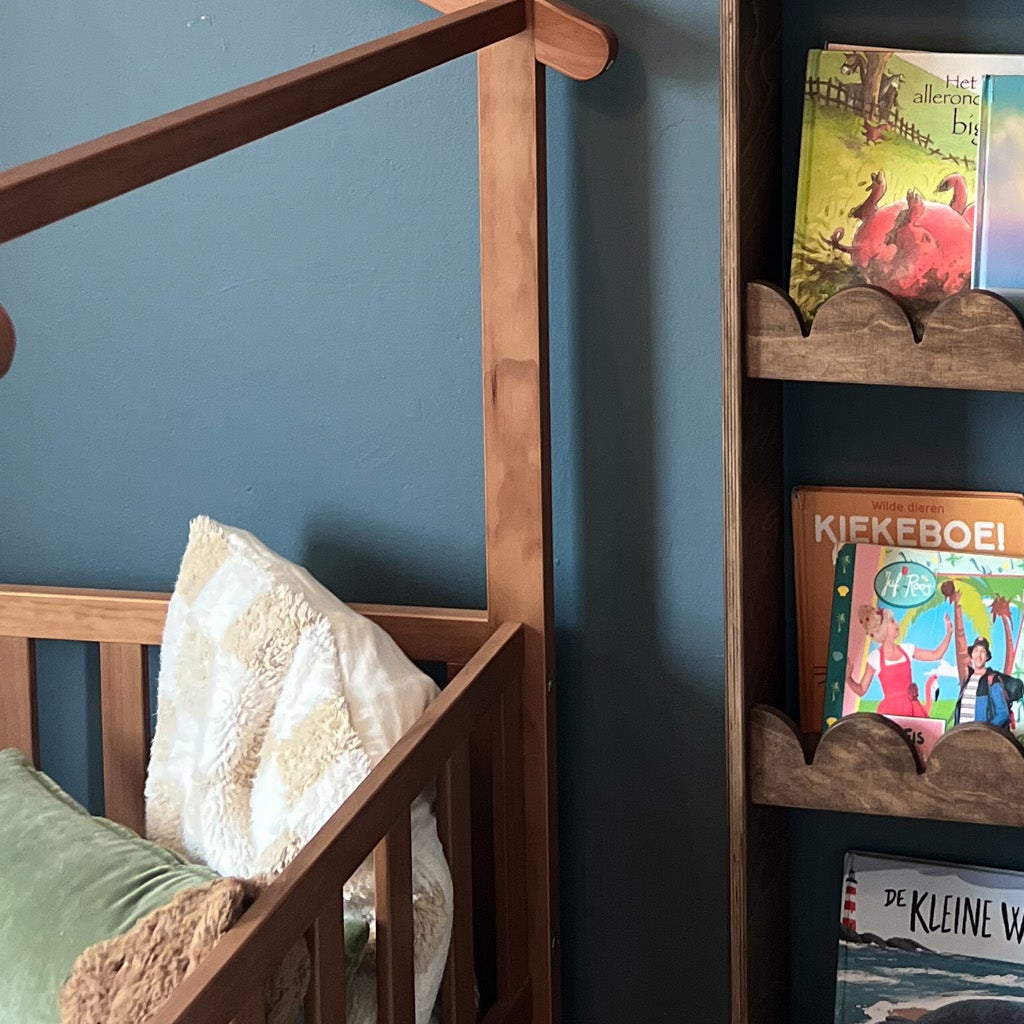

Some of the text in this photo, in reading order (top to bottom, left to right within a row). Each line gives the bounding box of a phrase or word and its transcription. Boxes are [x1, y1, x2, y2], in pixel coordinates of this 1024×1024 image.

[946, 74, 978, 89] Het
[871, 500, 945, 514] Wilde dieren
[814, 514, 1005, 551] KIEKEBOE!
[884, 888, 906, 908] DE
[910, 890, 993, 938] KLEINE
